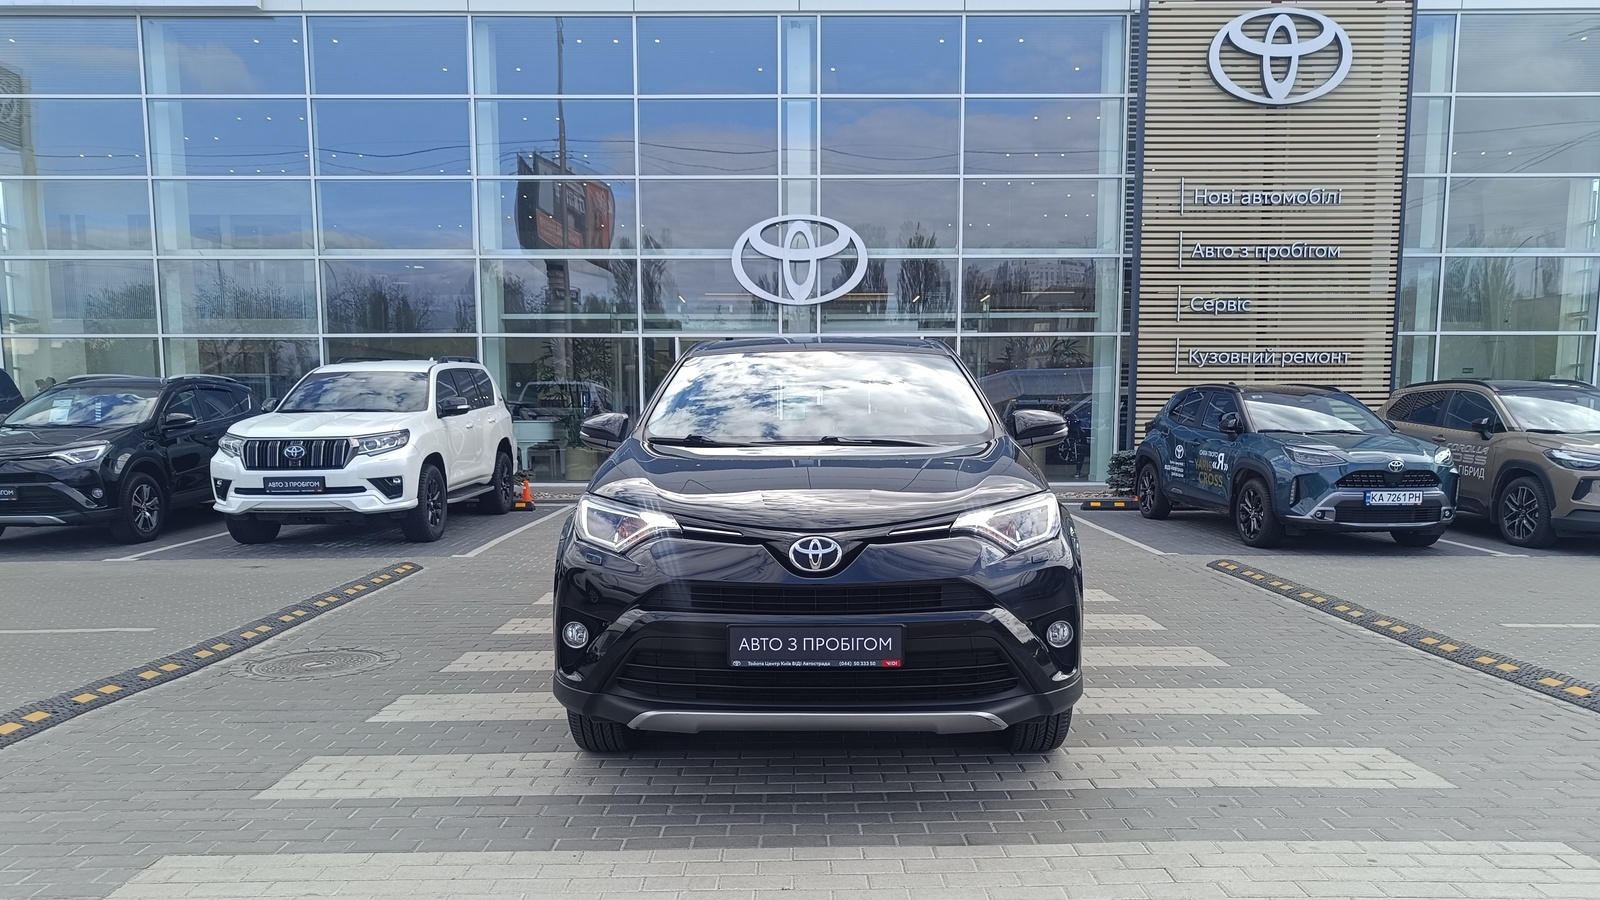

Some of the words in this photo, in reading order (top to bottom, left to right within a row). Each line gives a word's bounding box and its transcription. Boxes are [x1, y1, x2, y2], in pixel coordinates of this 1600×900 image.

[1194, 188, 1236, 205] Нові
[1241, 188, 1343, 205] автомобілі
[1191, 242, 1234, 258] Авто
[1239, 246, 1249, 258] з
[1255, 241, 1341, 262] пробігом
[1189, 296, 1252, 316] Сервіс
[1188, 348, 1275, 368] Кузовний
[1281, 351, 1351, 368] ремонт
[1194, 457, 1213, 472] YARIS
[1452, 452, 1487, 466] OSS
[1198, 471, 1223, 488] CROSS
[1457, 464, 1485, 480] ГІБРИД
[1386, 492, 1407, 503] 7261
[738, 637, 783, 651] АВТО
[787, 637, 798, 651] З
[803, 637, 892, 651] ПРОБІГОМ
